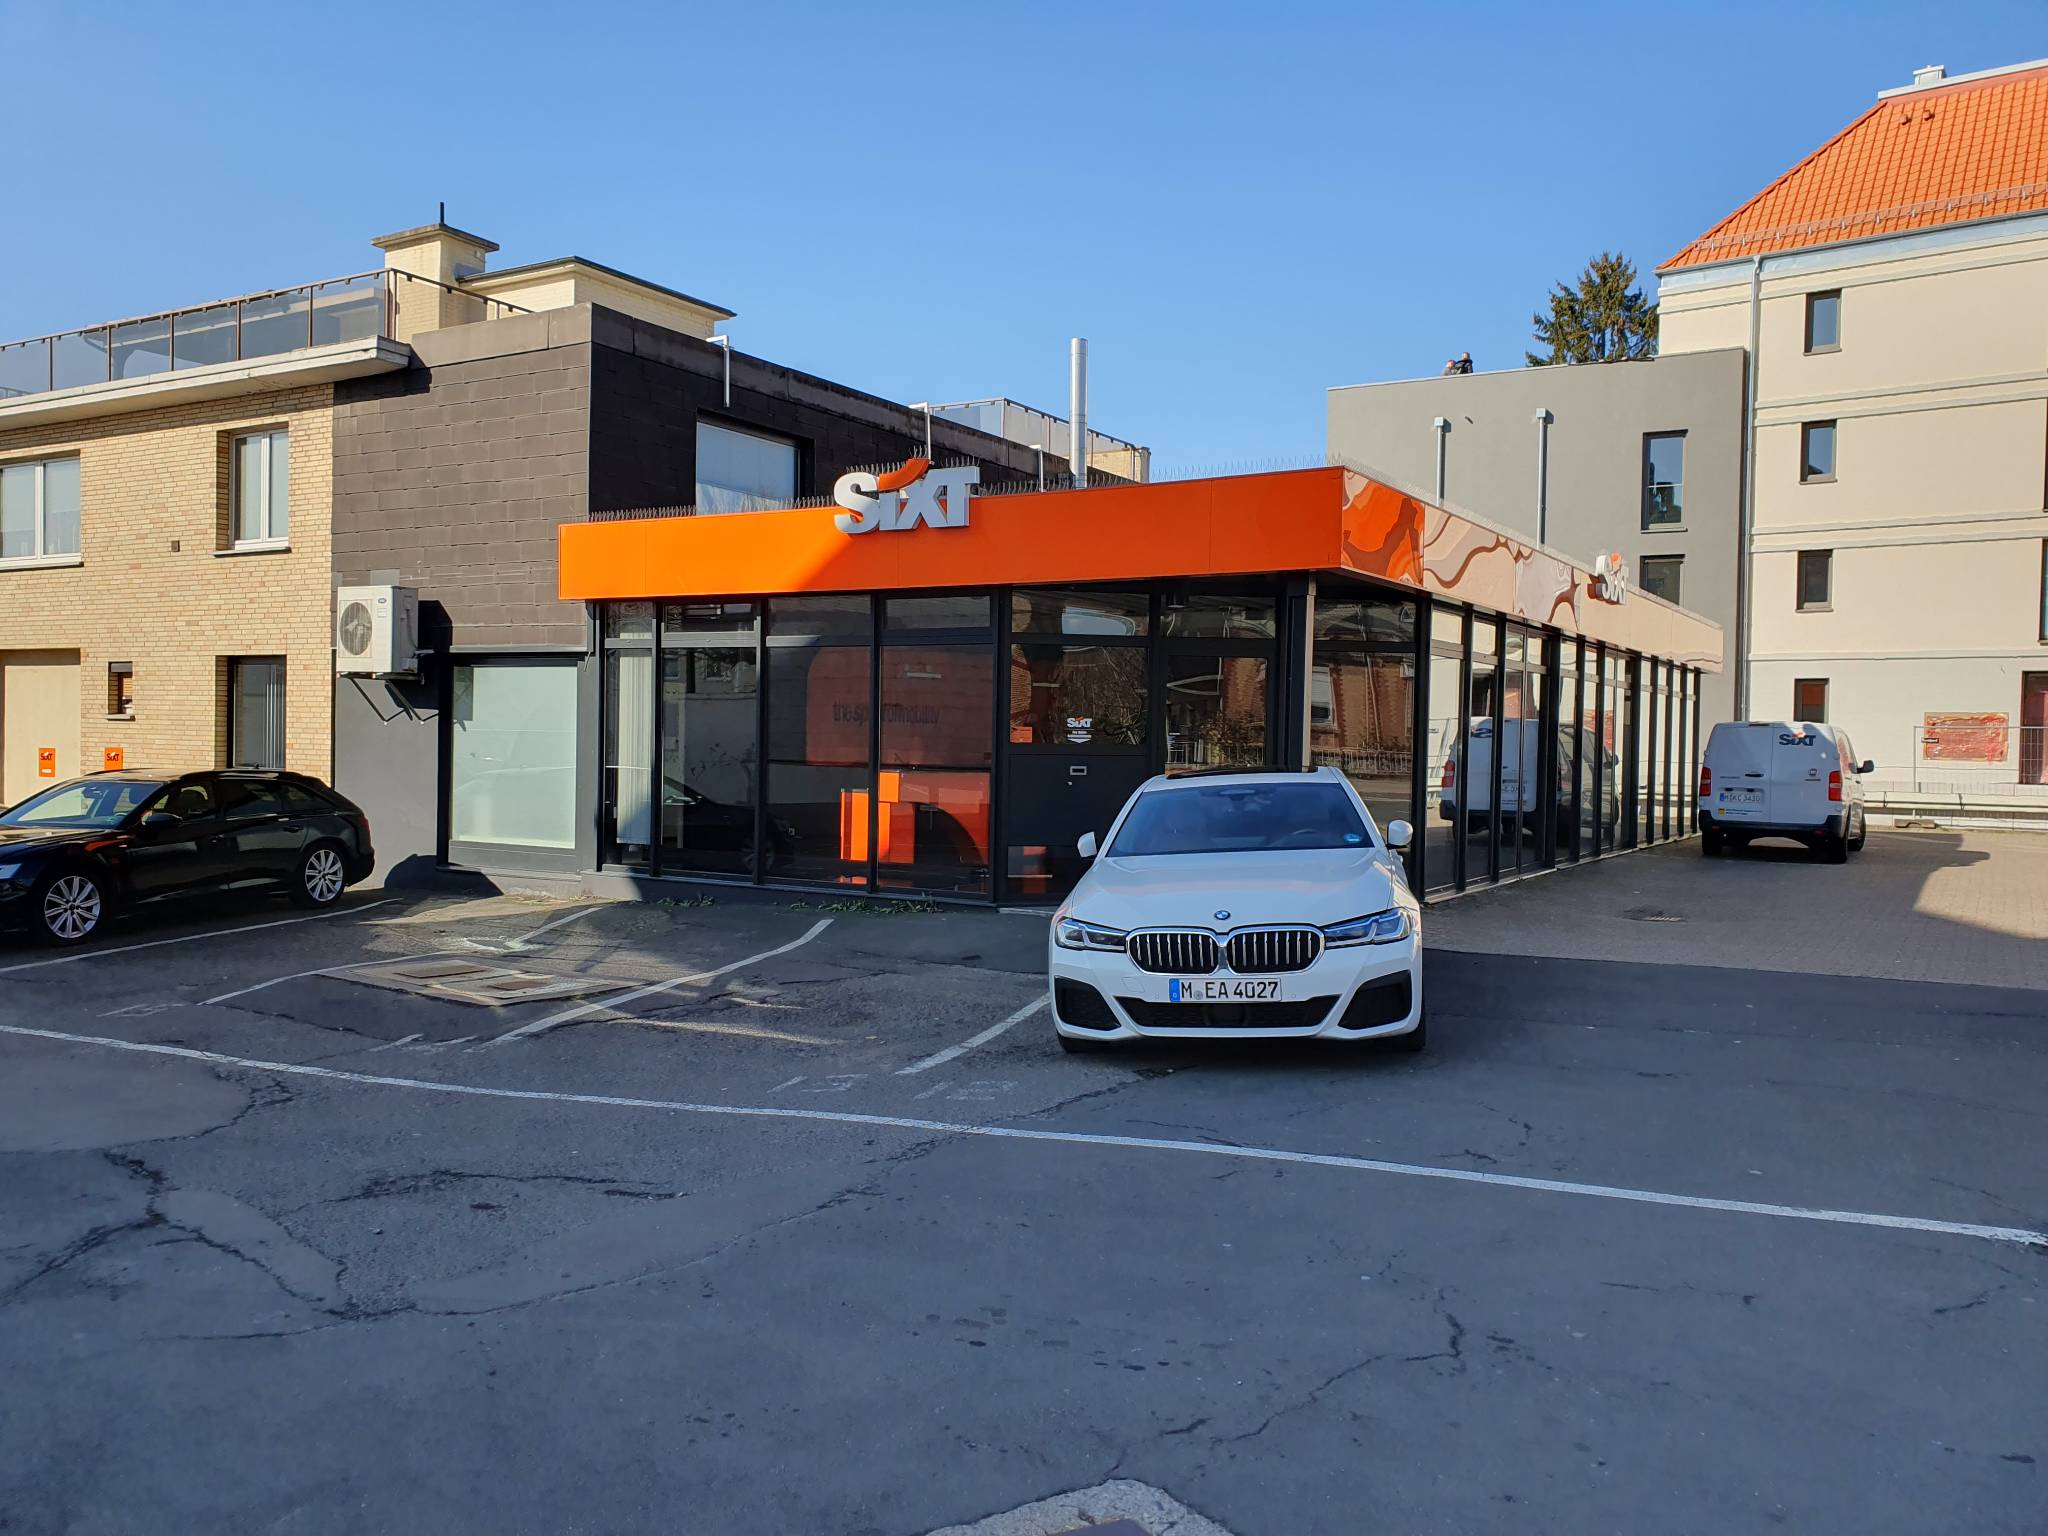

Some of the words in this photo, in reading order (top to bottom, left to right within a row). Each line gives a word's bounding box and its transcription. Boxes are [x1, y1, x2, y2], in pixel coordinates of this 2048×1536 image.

[833, 459, 980, 534] SIXT
[1067, 715, 1092, 727] SIXT
[1779, 732, 1816, 746] SIXT
[1181, 982, 1192, 998] M
[1205, 982, 1229, 998] EA
[1233, 982, 1278, 998] 4027
